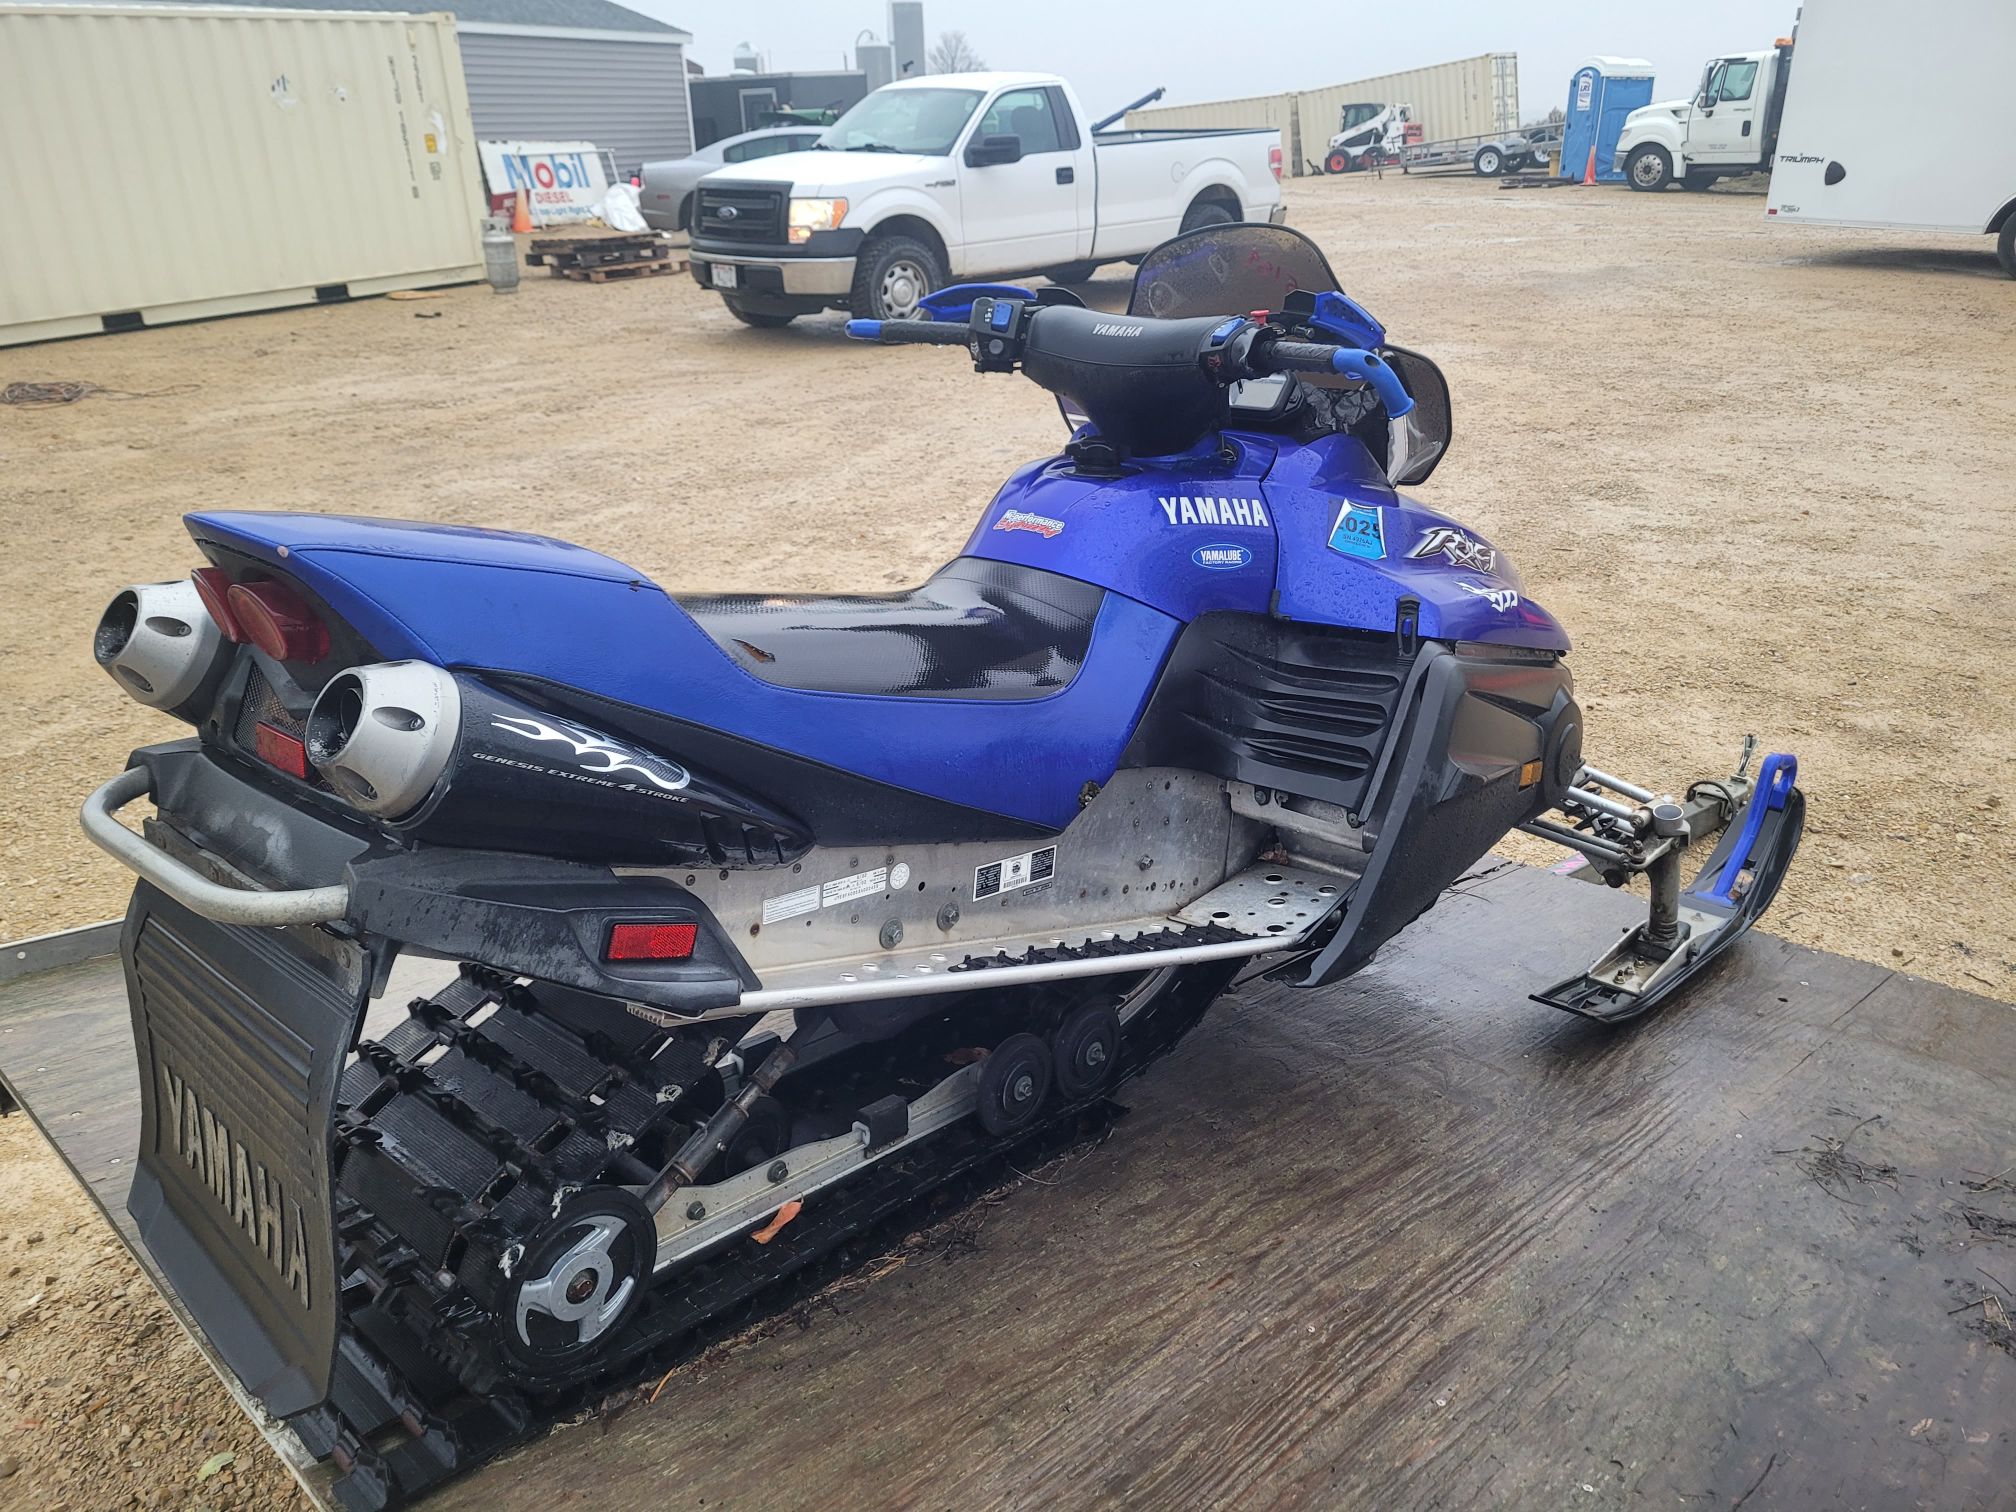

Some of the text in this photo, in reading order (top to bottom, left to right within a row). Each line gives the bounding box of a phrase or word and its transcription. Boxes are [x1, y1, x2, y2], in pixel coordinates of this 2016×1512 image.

[1780, 153, 1824, 164] TRIUMPH
[502, 153, 590, 189] Mobil
[535, 191, 574, 204] DIESEL
[1092, 323, 1144, 338] YAMAHA
[1158, 497, 1269, 527] YAMAHA
[1200, 549, 1243, 561] YAMALUBE
[472, 752, 689, 803] GENESIS EXTREME 4-STROKE
[162, 1063, 310, 1311] YAMAHA
